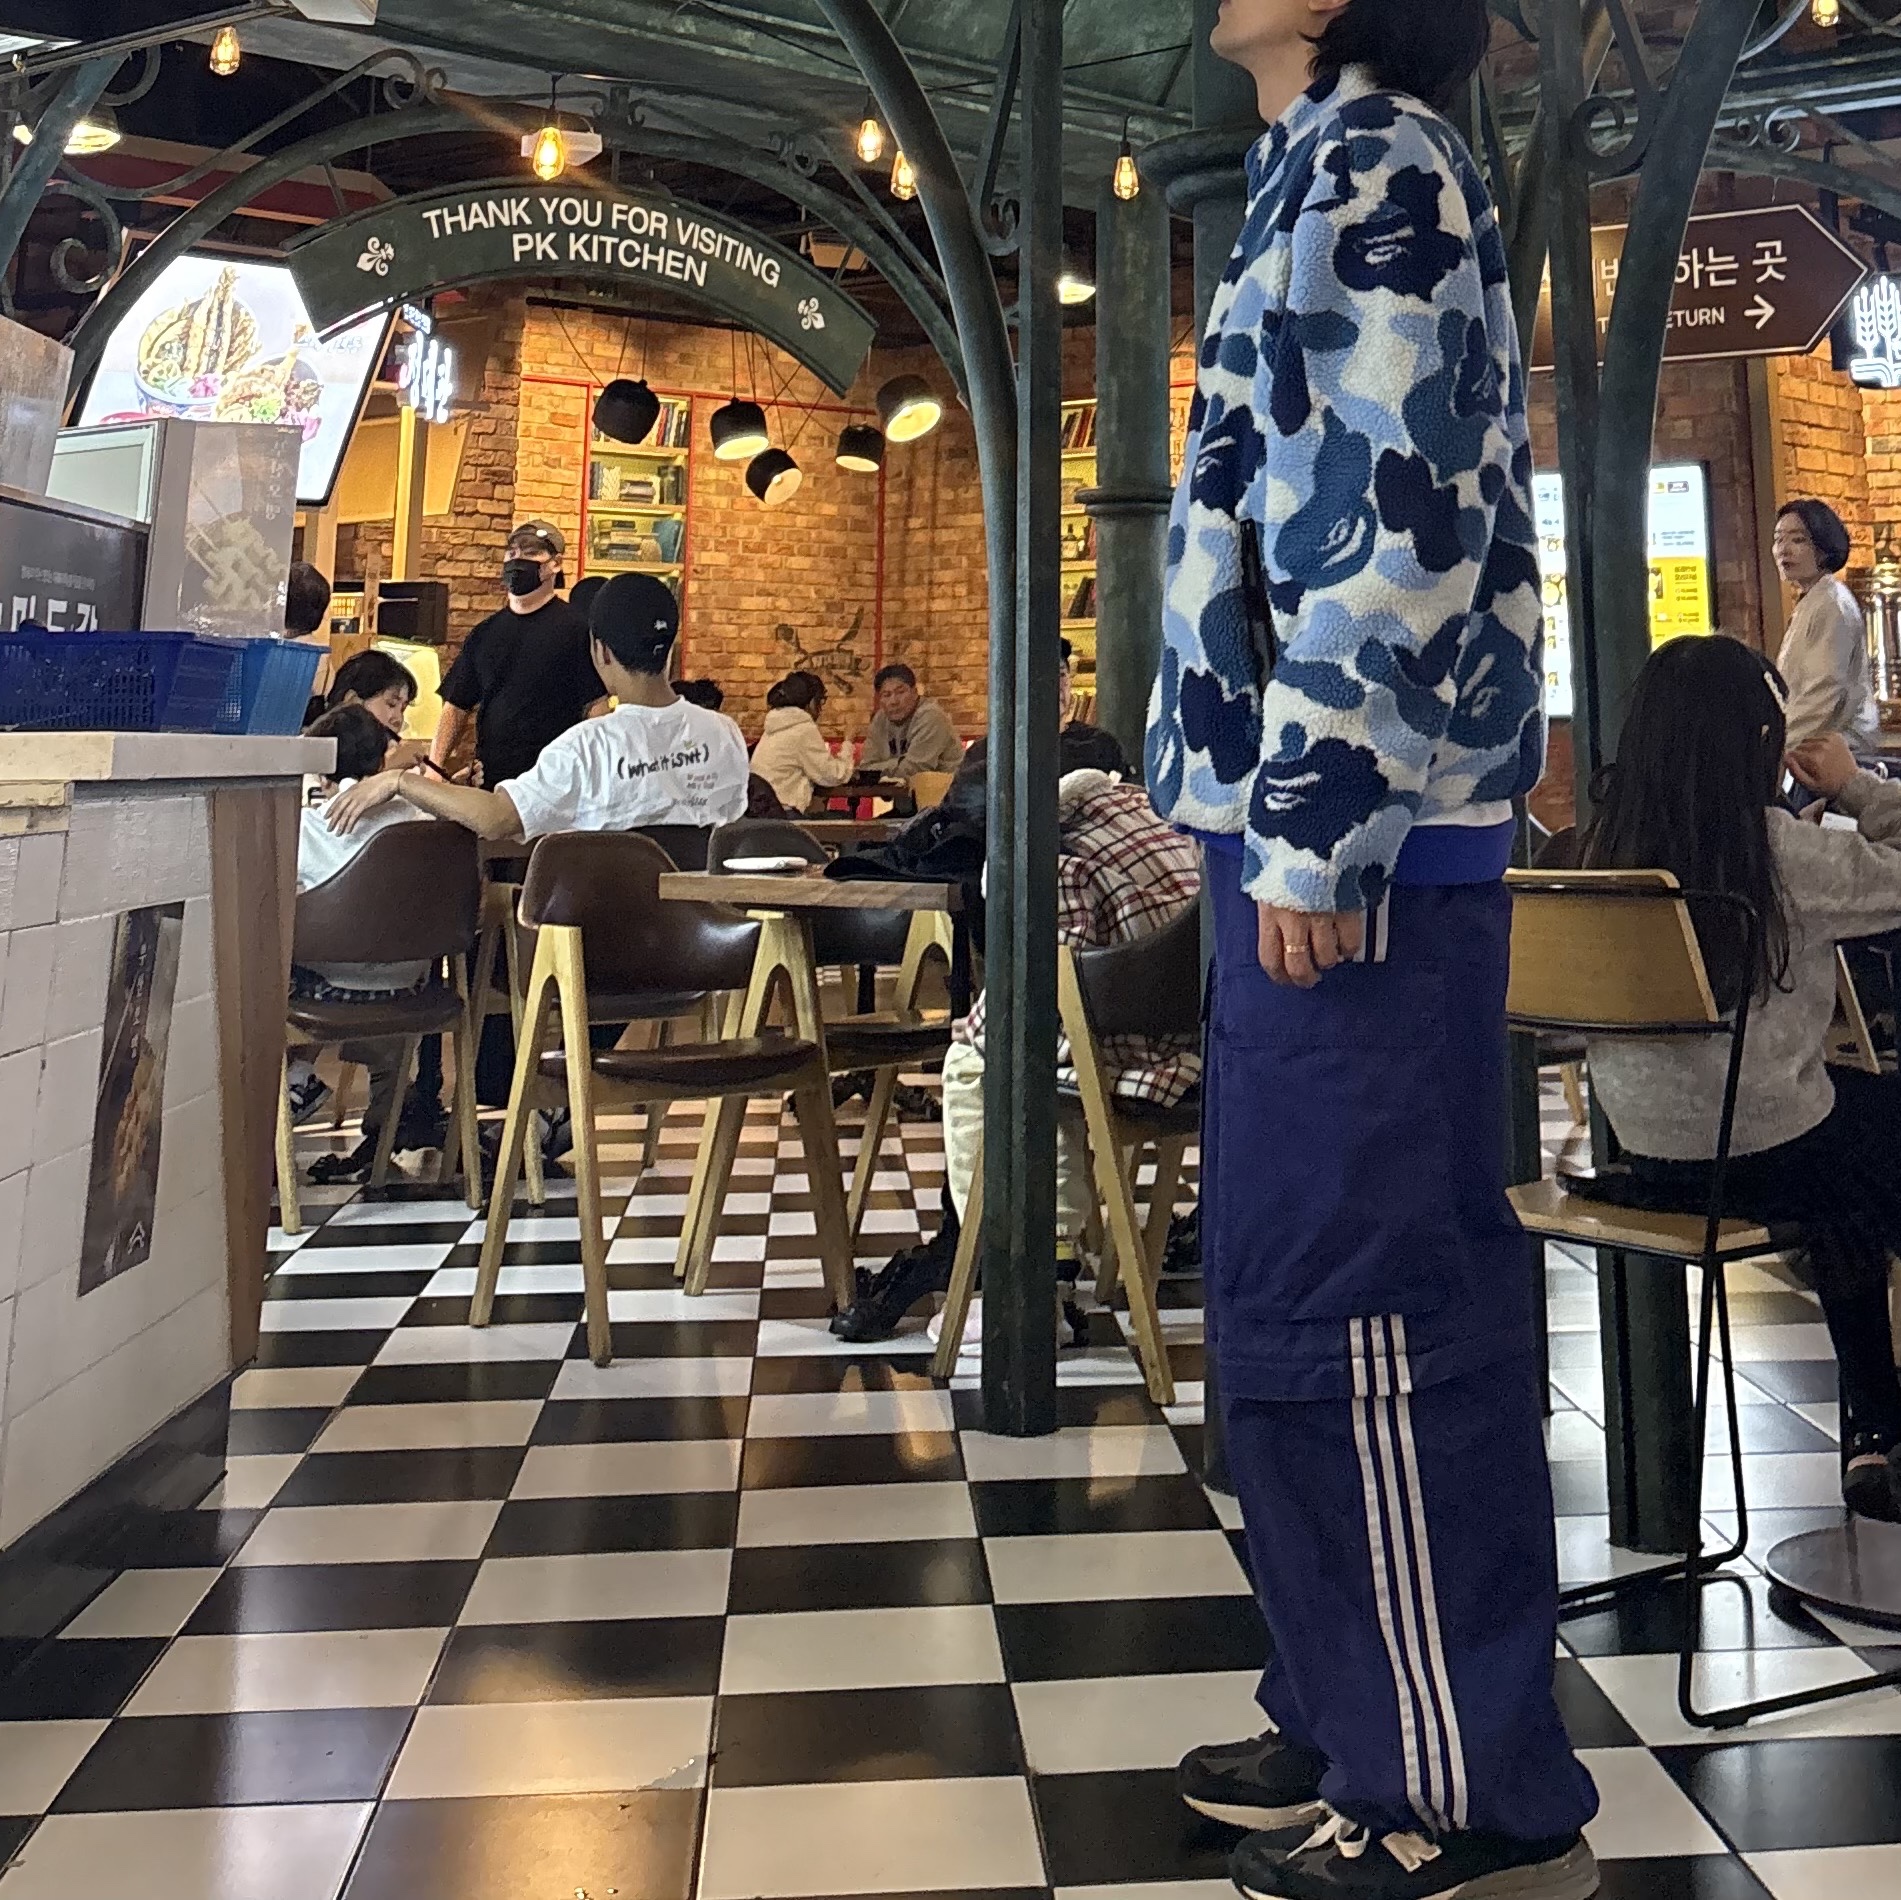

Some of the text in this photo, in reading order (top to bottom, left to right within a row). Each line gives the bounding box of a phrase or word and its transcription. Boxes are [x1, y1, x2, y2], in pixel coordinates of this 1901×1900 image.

[422, 197, 781, 288] THANK YOU FOR VISITING
[512, 232, 707, 287] PK KITCHEN
[1752, 240, 1788, 284] 곳
[1665, 305, 1726, 329] ETURN
